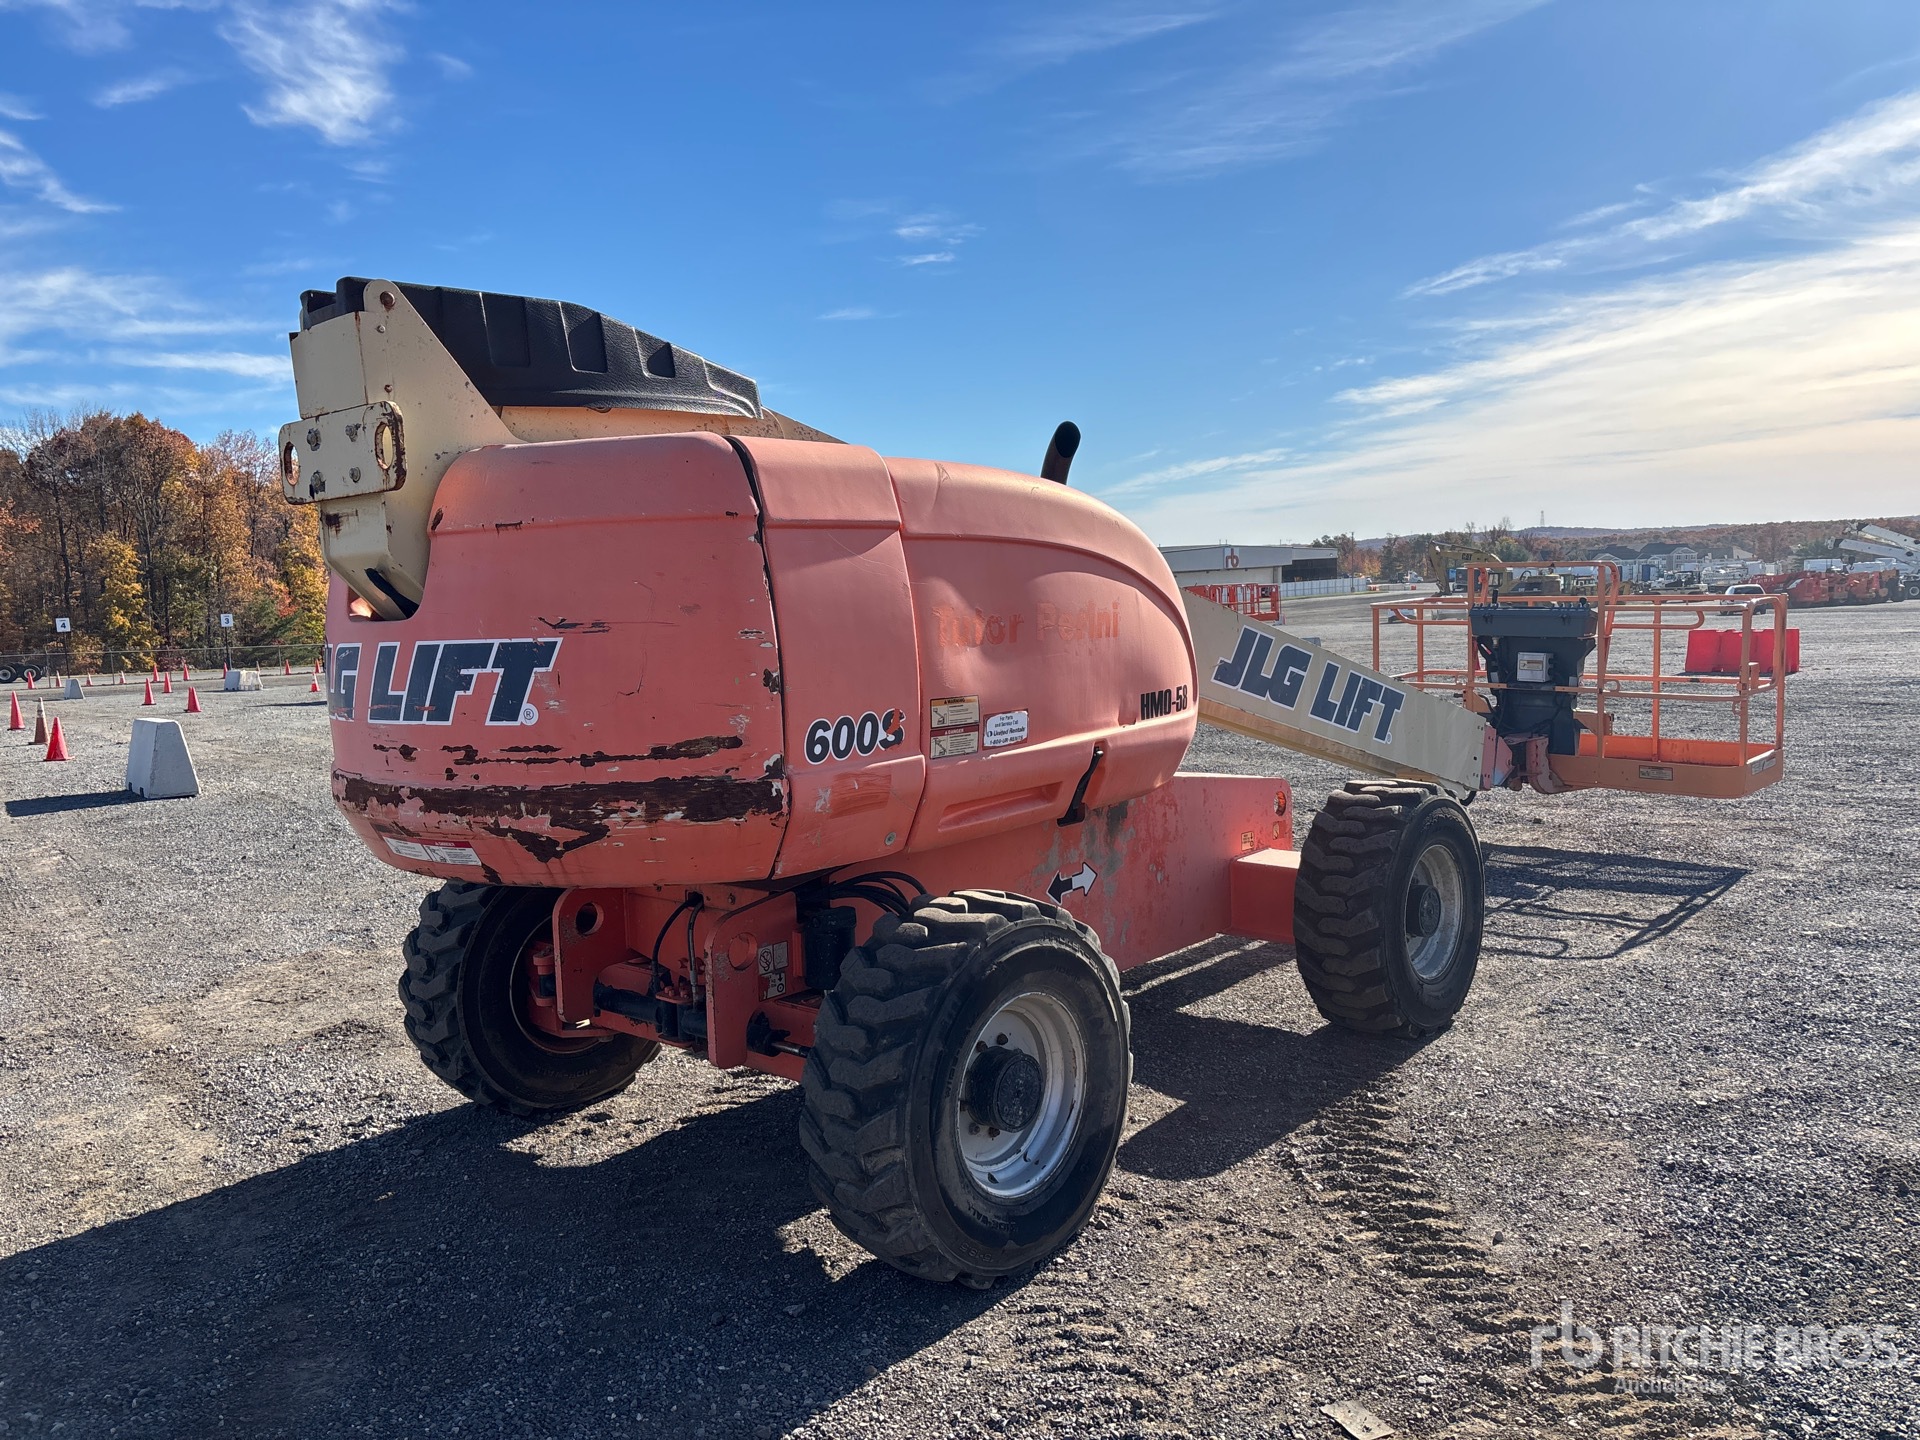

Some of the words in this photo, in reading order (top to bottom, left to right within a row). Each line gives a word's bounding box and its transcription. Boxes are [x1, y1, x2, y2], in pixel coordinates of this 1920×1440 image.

[1225, 547, 1240, 568] rb
[368, 637, 563, 725] LIFT
[1140, 685, 1188, 721] HMO-58
[1211, 625, 1313, 710] JLG
[1308, 660, 1406, 744] LIFT
[804, 708, 906, 765] 600S
[993, 729, 1009, 737] United
